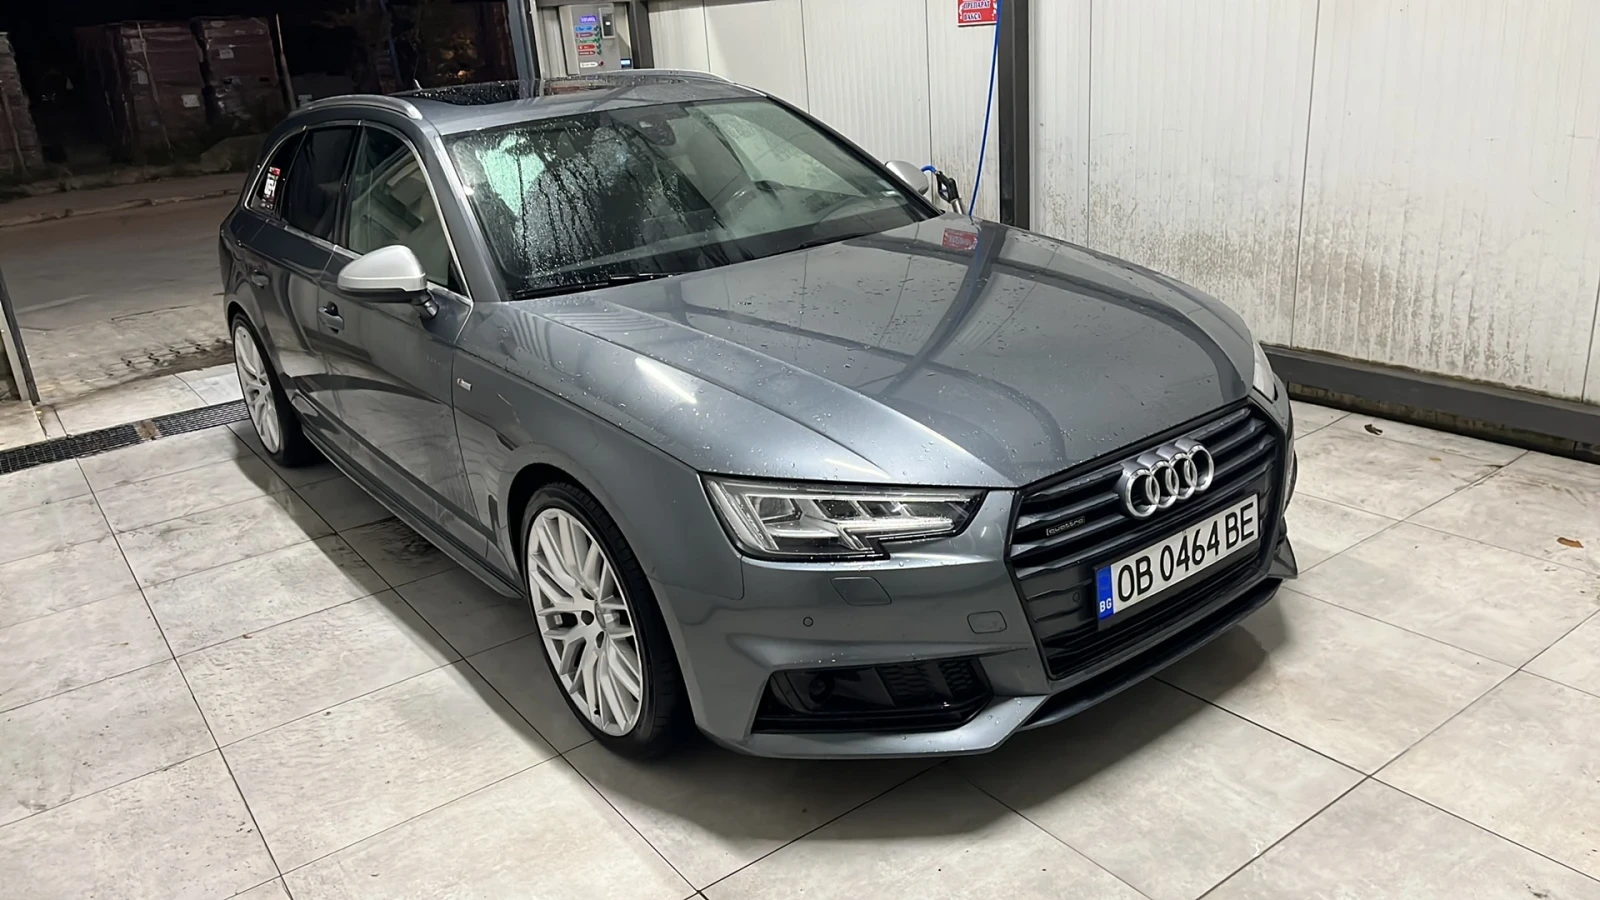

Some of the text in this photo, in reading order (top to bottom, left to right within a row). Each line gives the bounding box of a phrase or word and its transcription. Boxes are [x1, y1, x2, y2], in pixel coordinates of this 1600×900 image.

[963, 1, 990, 9] ПРЕПАРАТ
[1118, 502, 1254, 602] OB 0464 BE
[1100, 598, 1112, 612] BG
